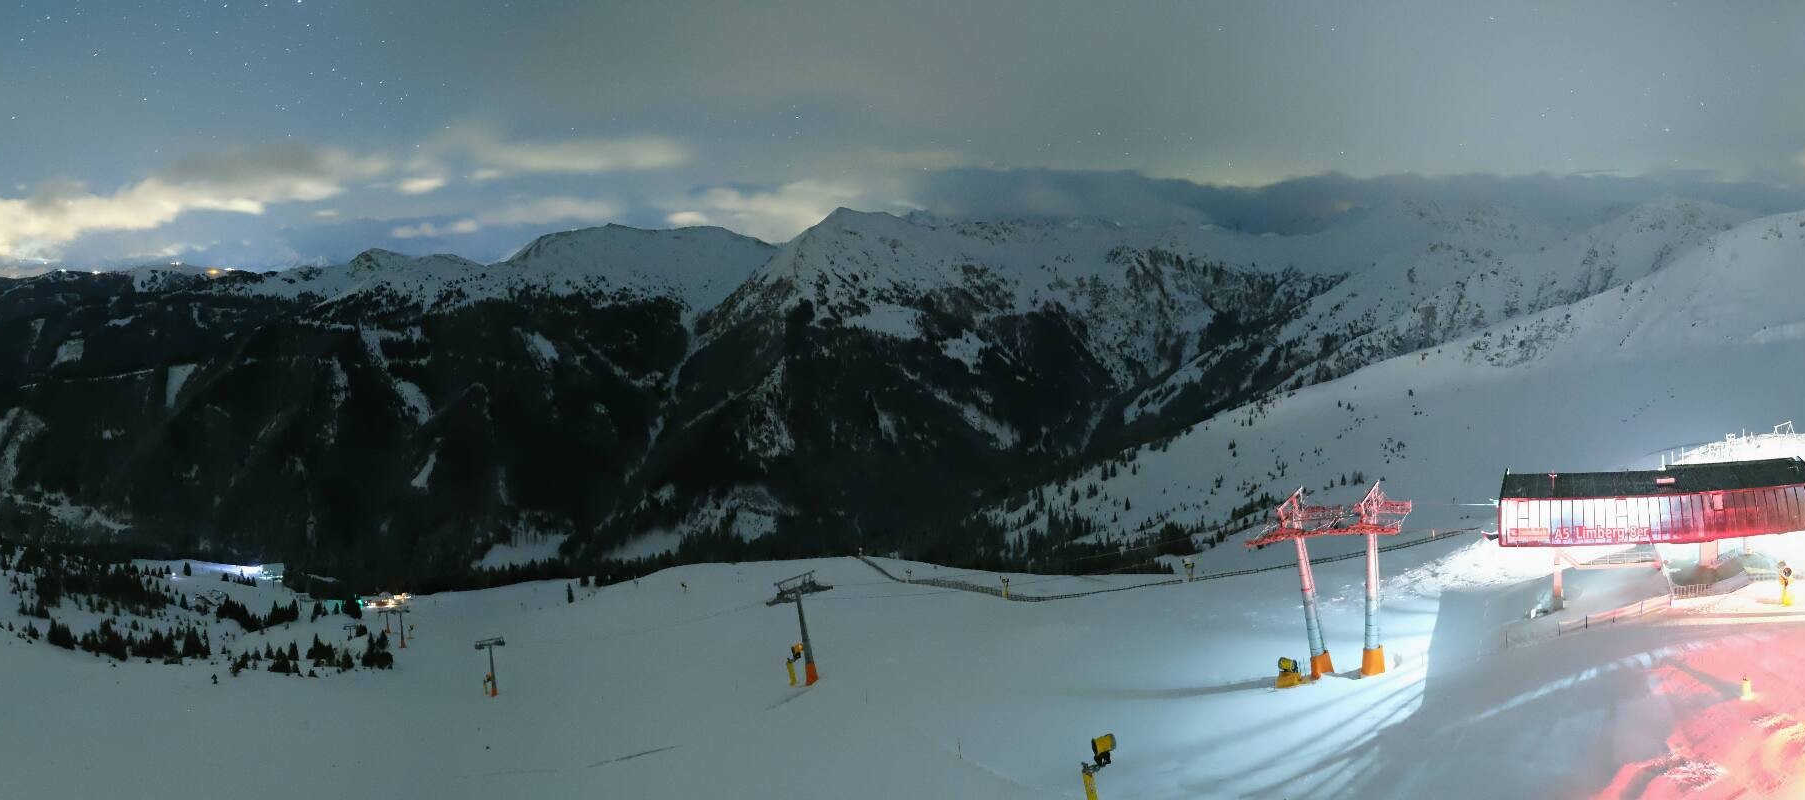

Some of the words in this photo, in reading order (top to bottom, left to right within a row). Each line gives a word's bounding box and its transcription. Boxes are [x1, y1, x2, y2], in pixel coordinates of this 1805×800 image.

[1555, 528, 1570, 540] A5
[1576, 526, 1625, 541] Limberg
[1629, 526, 1648, 538] 8er
